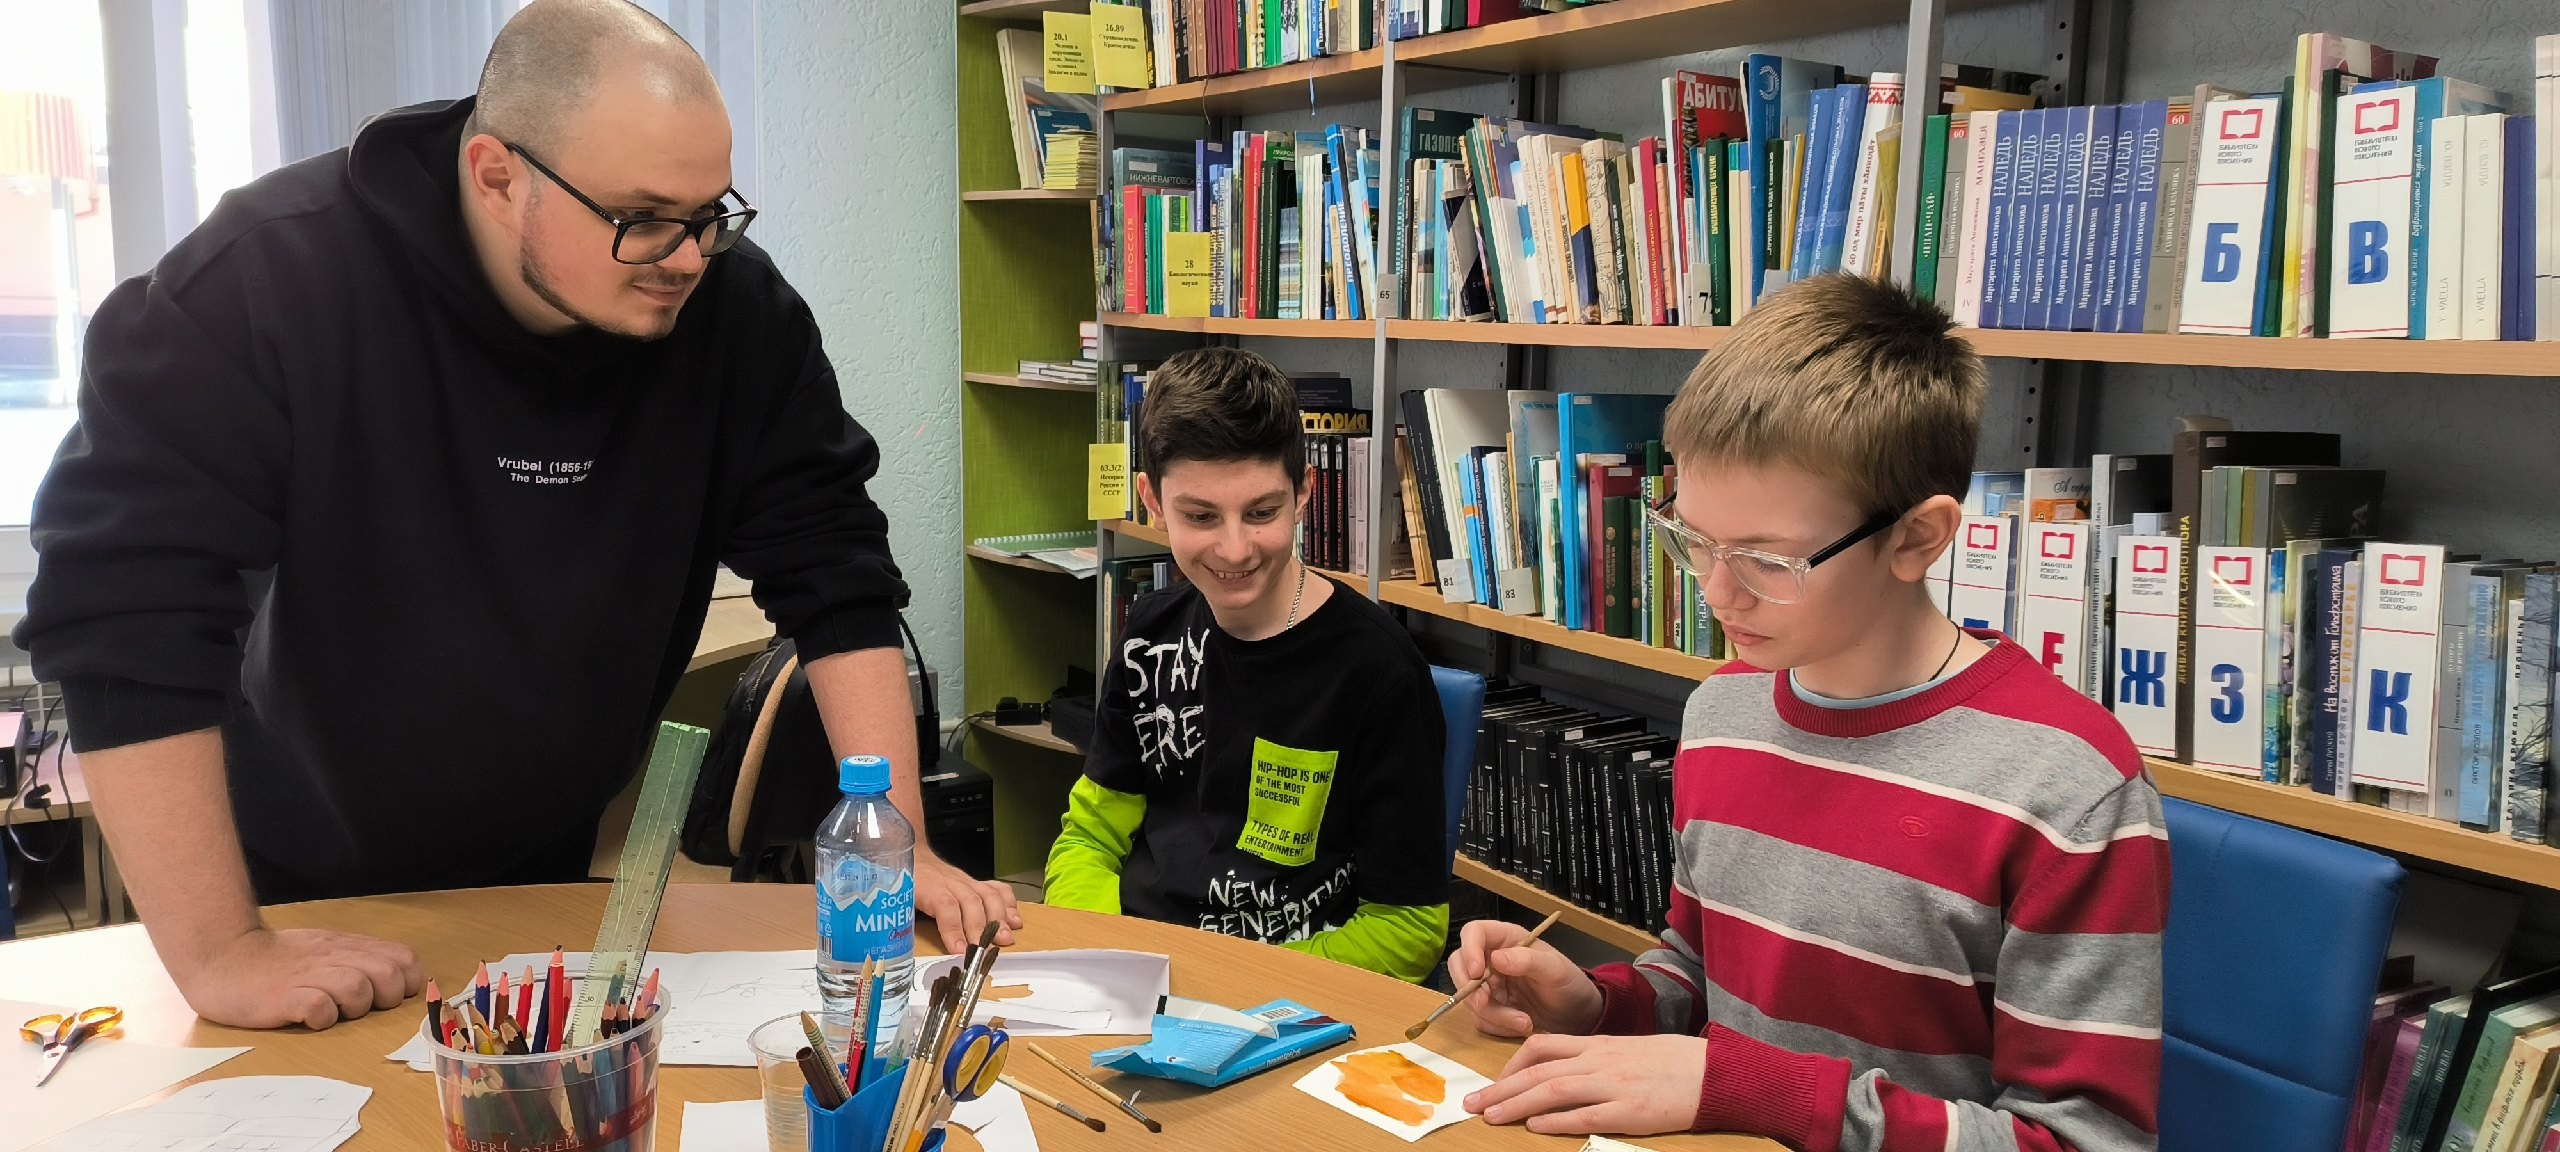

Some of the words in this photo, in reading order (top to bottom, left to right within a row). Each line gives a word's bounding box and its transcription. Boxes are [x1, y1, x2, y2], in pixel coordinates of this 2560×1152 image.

[1053, 32, 1068, 41] 20.1
[1682, 74, 1742, 113] АБИТУ
[1952, 129, 1965, 138] 60
[2171, 114, 2185, 125] 60
[1975, 125, 1988, 186] МАНГАЗЕЯ
[1993, 136, 2012, 197] НАЛЕДЬ
[2018, 134, 2038, 196] НАЛЕДЬ
[2040, 133, 2062, 195] НАЛЕДЬ
[2065, 132, 2086, 195] НАЛЕДЬ
[2089, 135, 2111, 198] НАЛЕДЬ
[2113, 130, 2134, 194] НАЛЕДЬ
[2138, 127, 2160, 192] НАЛЕДЬ
[1338, 201, 1353, 283] ПРЕОДОЛЕНИЕ
[1991, 205, 2002, 257] Анисимкова
[2015, 204, 2027, 256] Анисимкова
[2037, 203, 2050, 255] Анисимкова
[2062, 204, 2074, 256] Анисимкова
[2084, 207, 2098, 260] Анисимкова
[2109, 203, 2122, 256] Анисимкова
[2134, 201, 2147, 256] Анисимкова
[2202, 223, 2241, 283] Б
[2348, 220, 2389, 285] В
[1379, 290, 1390, 299] 65
[1986, 259, 1996, 303] Маргарита
[2009, 258, 2022, 304] Маргарита
[2031, 258, 2044, 304] Маргарита
[2055, 258, 2068, 304] Маргарита
[2078, 262, 2092, 309] Маргарита
[2102, 259, 2116, 306] Маргарита
[2127, 259, 2142, 306] Маргарита
[2439, 277, 2449, 311] VAELLA
[2476, 277, 2486, 311] VAELLA
[498, 456, 542, 471] Vrubel
[549, 459, 595, 475] (1856-19
[510, 472, 530, 483] The
[535, 475, 569, 484] Demon
[2180, 515, 2190, 592] САМОТЛОРА
[1443, 577, 1454, 587] 81
[1505, 588, 1516, 599] 83
[2325, 565, 2344, 636] Гольфстрима
[2179, 596, 2188, 636] КНИГА
[2341, 583, 2357, 683] БЕЛОГОРЬЕ
[1123, 627, 1210, 699] STAY
[2042, 631, 2065, 682] Е
[2119, 647, 2167, 708] Ж
[2177, 640, 2187, 684] ЖИВАЯ
[2210, 663, 2244, 723] З
[2324, 697, 2338, 713] На
[2367, 668, 2412, 735] К
[2510, 705, 2519, 762] КРЮКОВА
[1255, 787, 1301, 807] SUCCESSFUL
[1256, 775, 1264, 784] OF
[1267, 777, 1281, 790] THE
[1284, 781, 1306, 795] MOST
[1257, 760, 1298, 780] HIP-HOP
[1300, 769, 1309, 782] IS
[1313, 771, 1331, 784] ONE
[2505, 768, 2517, 822] ТАТЬЯНА
[1244, 834, 1305, 857] ENTERTAINMENT
[1251, 820, 1278, 839] TYPES
[1279, 829, 1291, 842] OF
[1293, 832, 1314, 845] REAL
[1208, 877, 1275, 908] NEW
